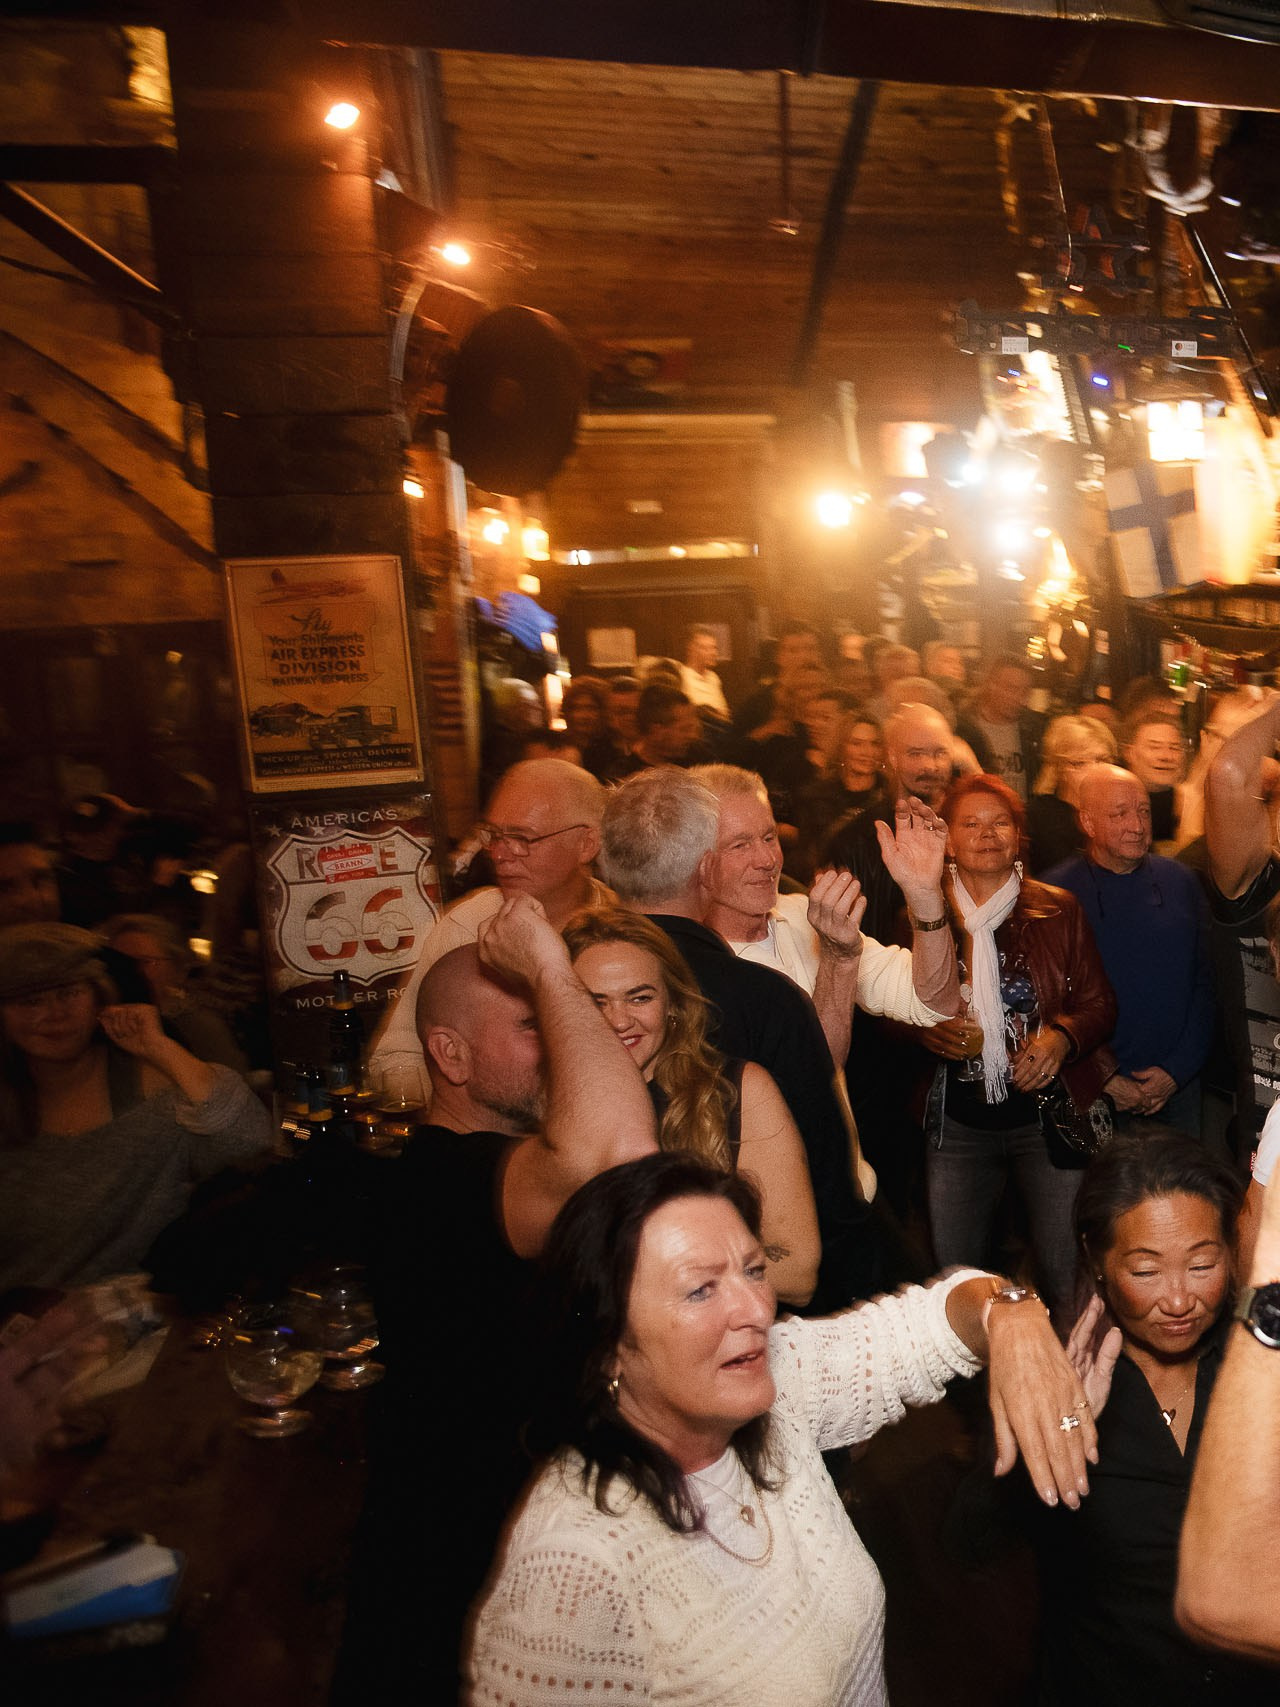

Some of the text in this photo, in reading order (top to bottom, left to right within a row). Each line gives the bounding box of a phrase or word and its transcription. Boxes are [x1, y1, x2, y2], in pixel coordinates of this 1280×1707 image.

[271, 645, 366, 661] AIR EXPRESS
[279, 660, 361, 675] DIVISION
[319, 673, 370, 684] EXPRESS
[291, 809, 398, 828] AMERICA'S
[334, 858, 364, 870] BRANN
[304, 886, 416, 966] 66
[297, 991, 378, 1008] MOTER
